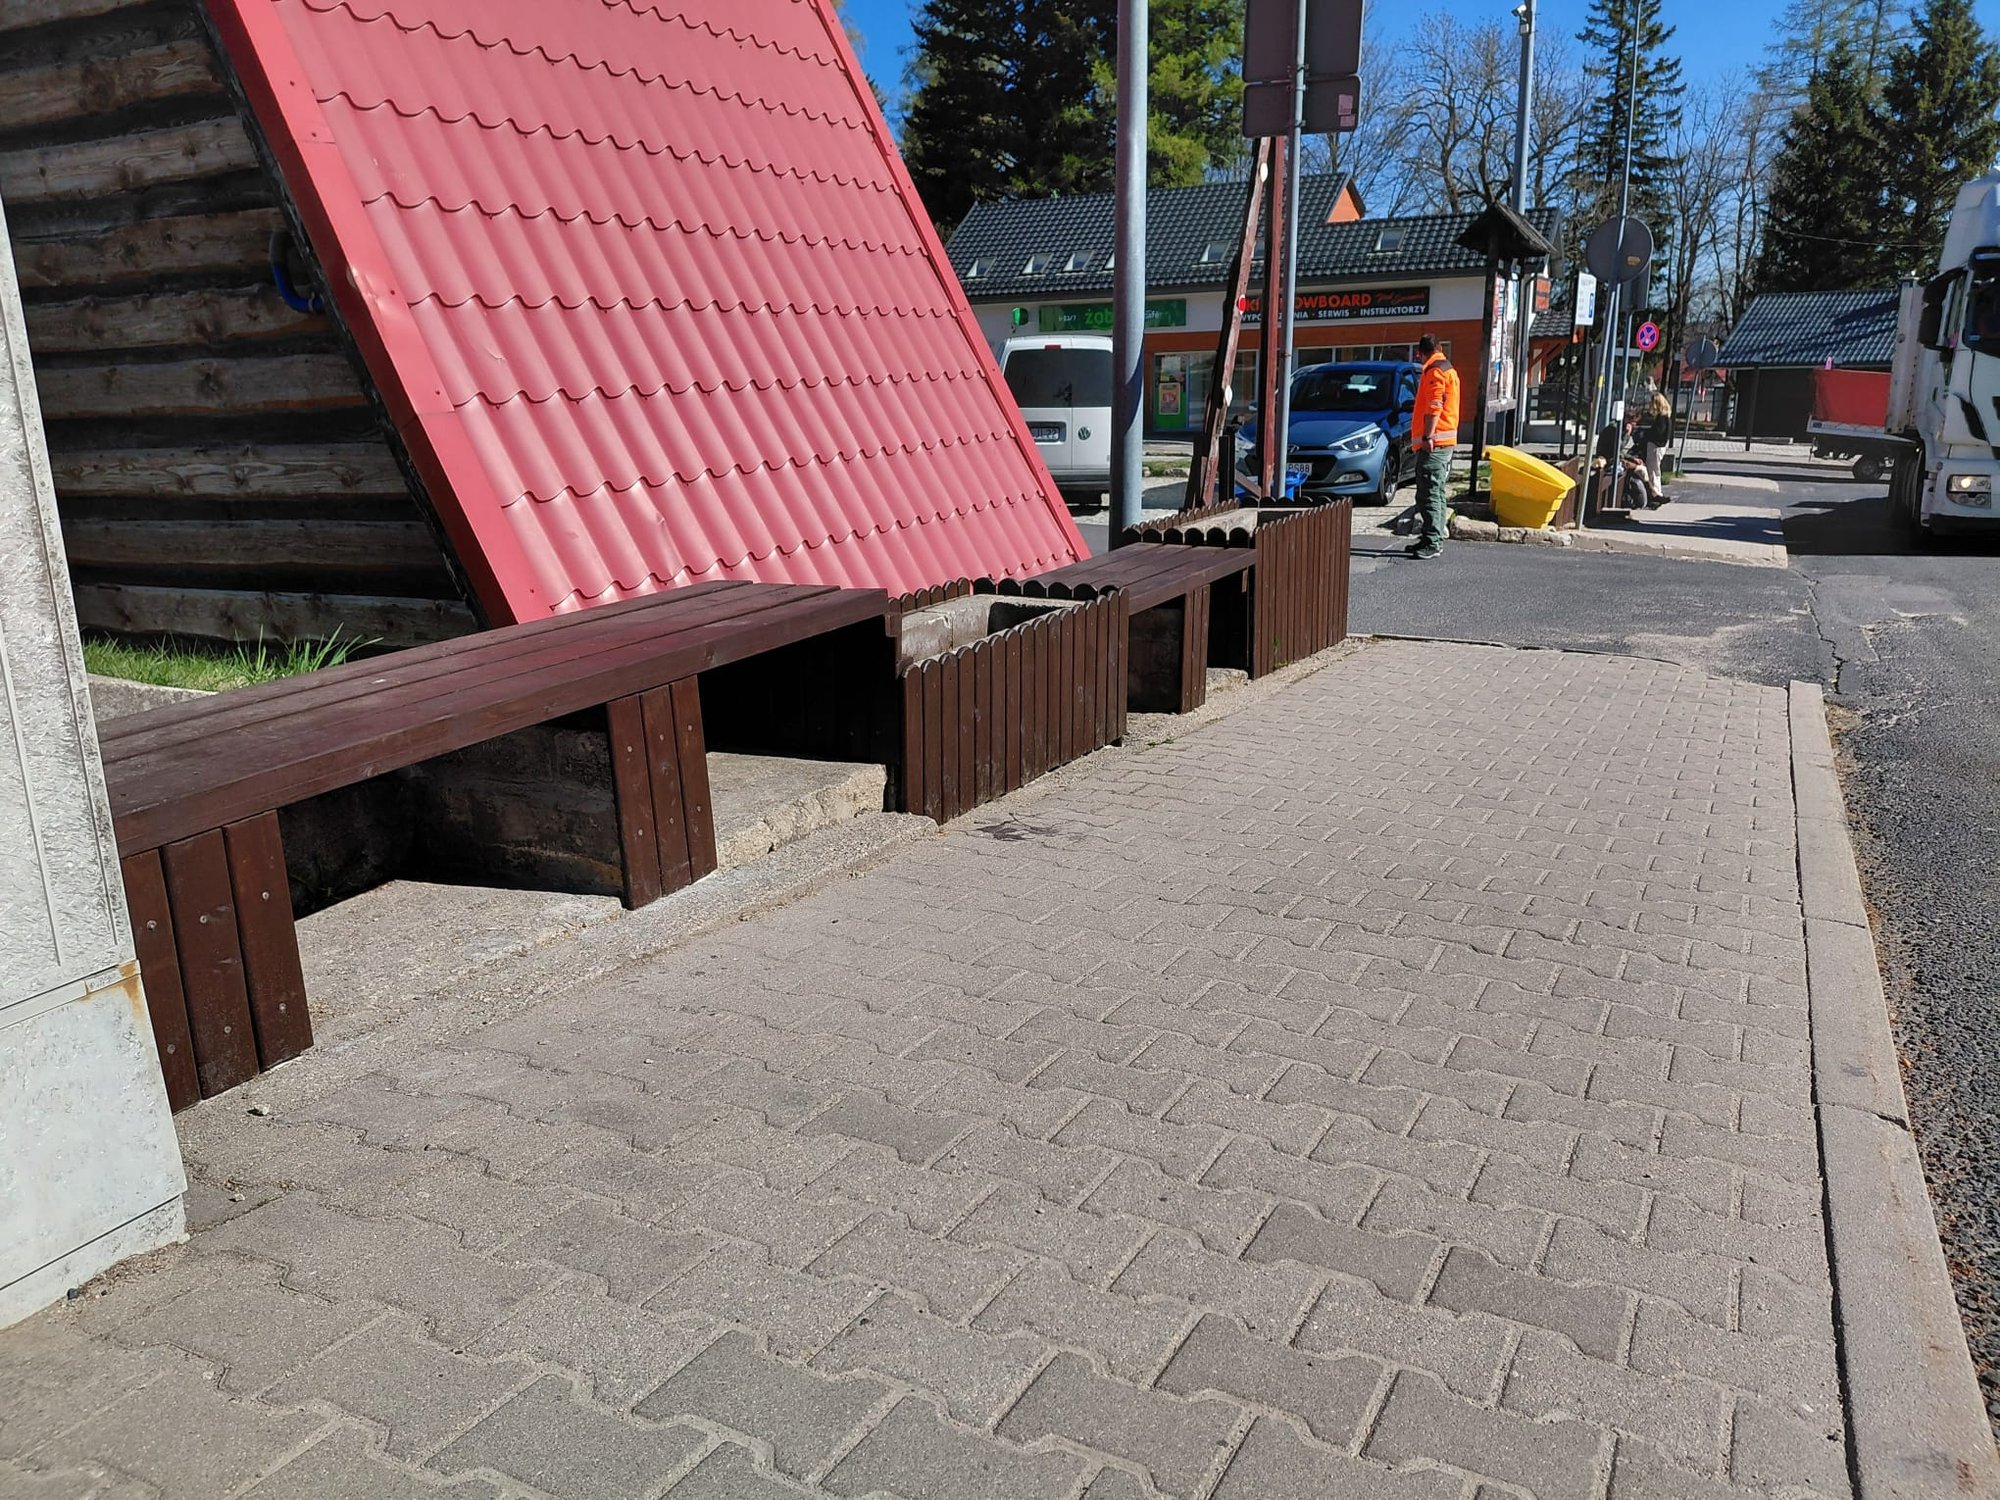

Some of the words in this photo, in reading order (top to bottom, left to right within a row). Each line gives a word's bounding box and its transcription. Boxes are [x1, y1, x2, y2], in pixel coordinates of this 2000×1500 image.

[1270, 293, 1372, 310] OWBOARD
[1317, 308, 1350, 319] SERWIS
[1360, 304, 1426, 317] INSTRUKTORZY
